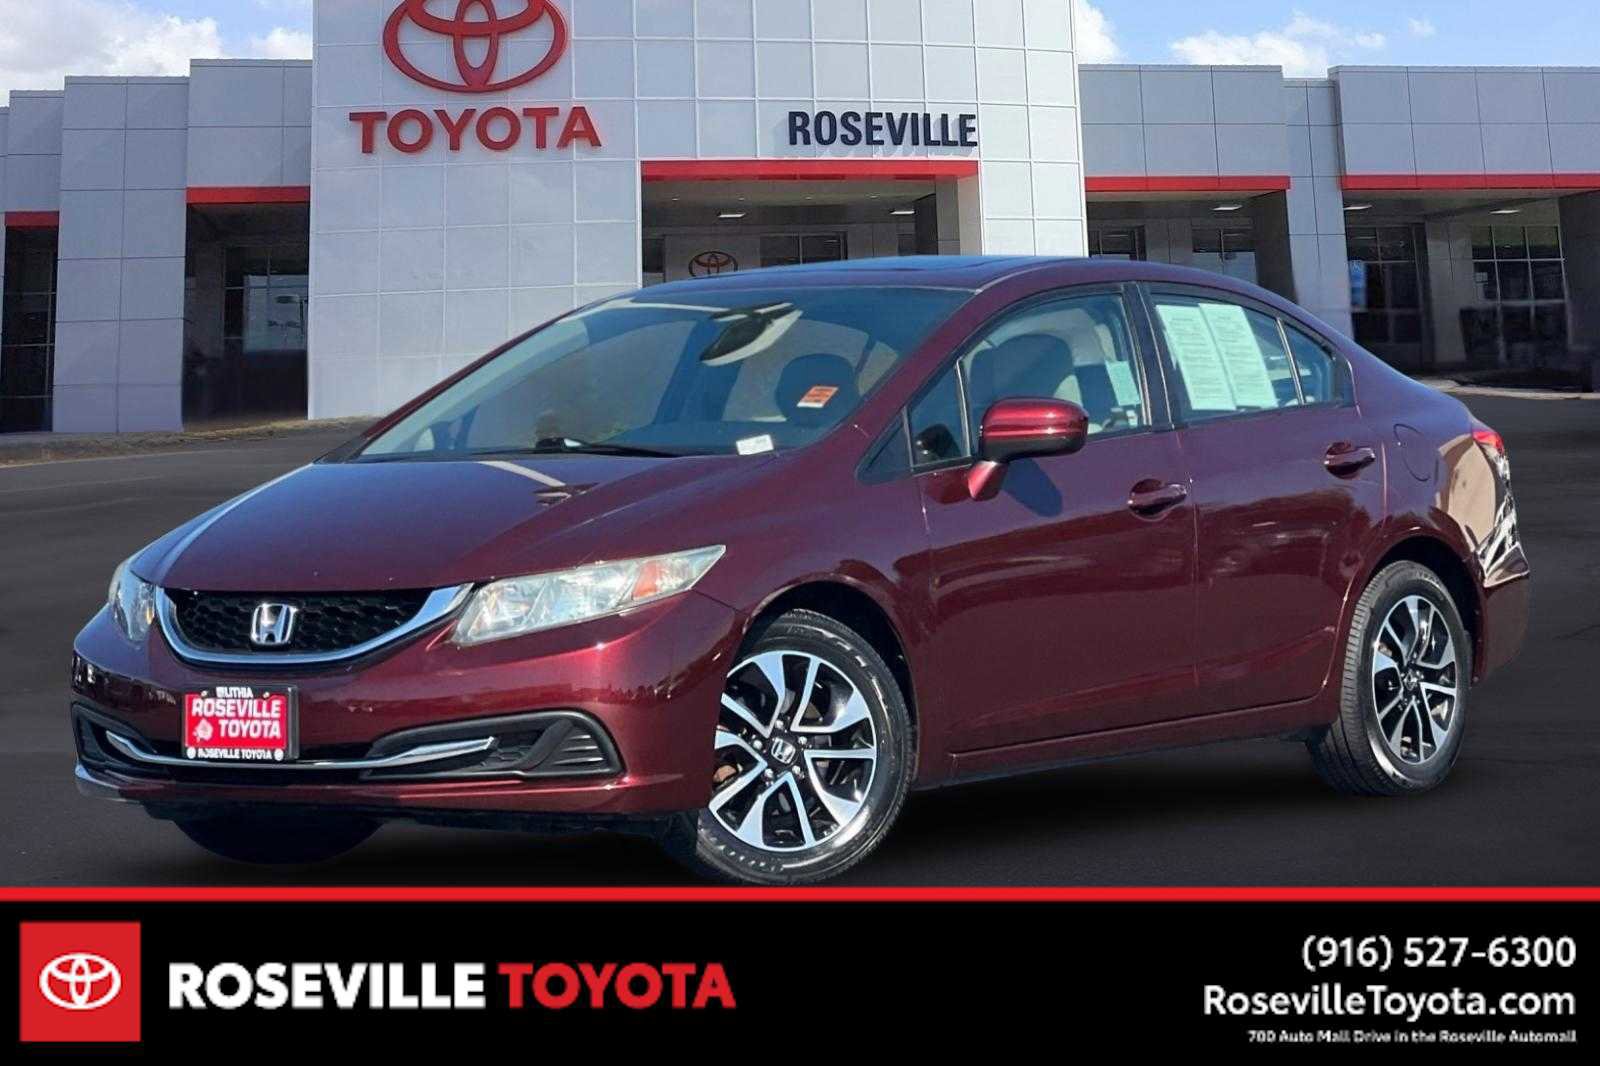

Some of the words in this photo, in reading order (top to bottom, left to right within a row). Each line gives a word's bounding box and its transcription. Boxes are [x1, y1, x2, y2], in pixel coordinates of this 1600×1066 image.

[349, 106, 602, 154] TOYOTA
[788, 111, 978, 148] ROSEVILLE
[191, 698, 281, 718] ROSEVILLE
[218, 719, 282, 738] TOYOTA
[197, 748, 240, 759] ROSEVILLE
[241, 748, 272, 760] TOYOTA
